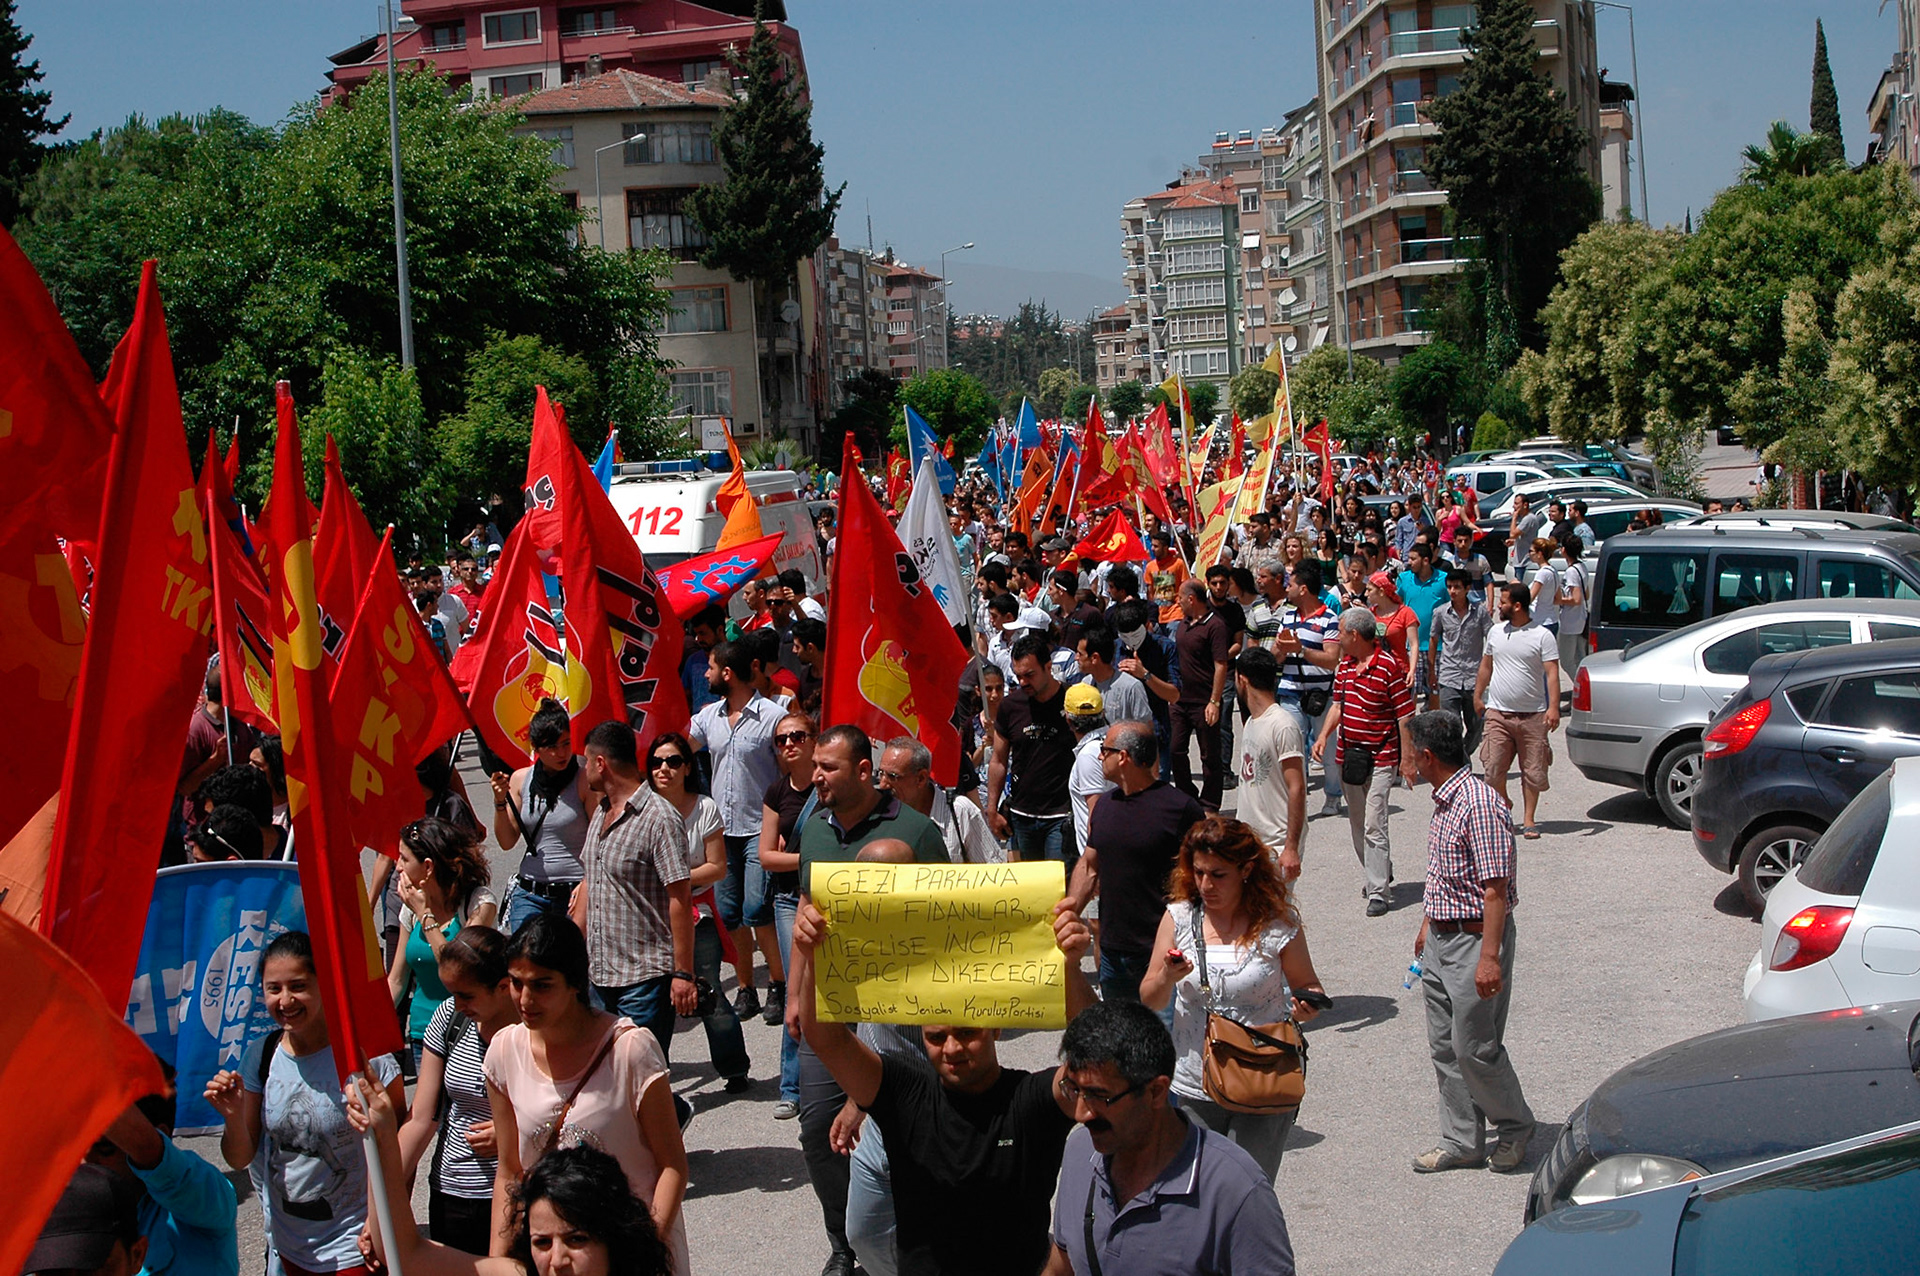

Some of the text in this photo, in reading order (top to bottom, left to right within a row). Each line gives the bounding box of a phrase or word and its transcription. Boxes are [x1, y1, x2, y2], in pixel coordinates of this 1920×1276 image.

[628, 507, 683, 536] 112
[827, 866, 1018, 895] GEZİ PARKINA
[818, 895, 1031, 924] YENİ FİDANLAR;
[821, 925, 1014, 960] MECLİSE İNCİR
[825, 958, 1063, 987] AĞACI DİKECEĞİZ.
[203, 967, 224, 1008] 1995
[218, 910, 267, 1066] KESK
[824, 992, 898, 1020] Sosyalist
[905, 995, 952, 1015] Yeniden
